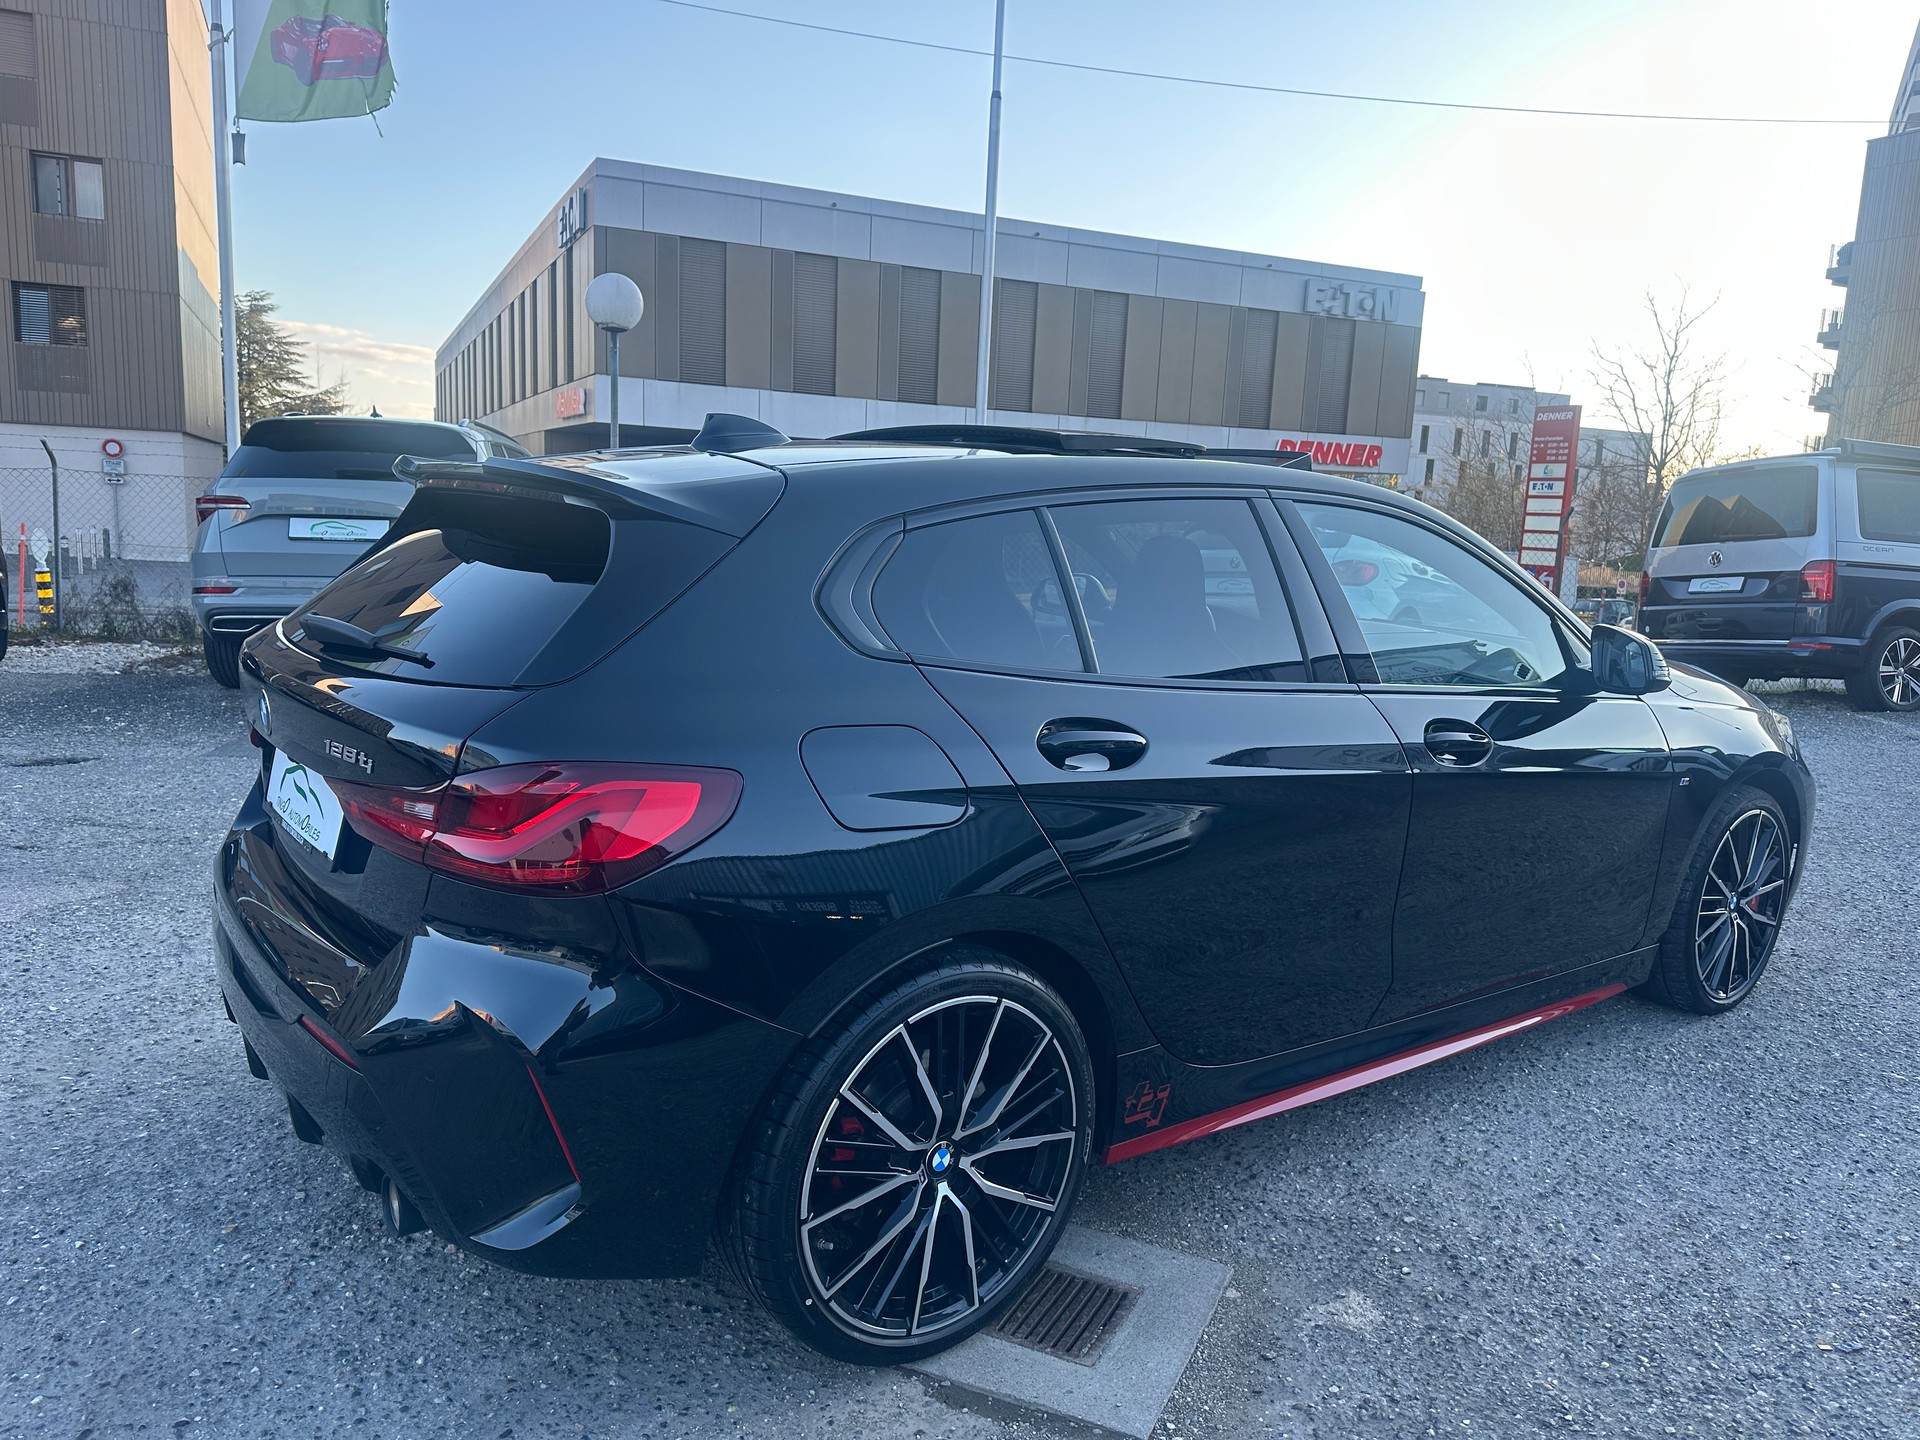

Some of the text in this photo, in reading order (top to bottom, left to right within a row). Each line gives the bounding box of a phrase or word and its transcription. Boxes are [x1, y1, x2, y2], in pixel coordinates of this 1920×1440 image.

[1304, 279, 1399, 322] EATON
[1536, 411, 1573, 421] DENNER
[1863, 545, 1894, 553] OCEAN
